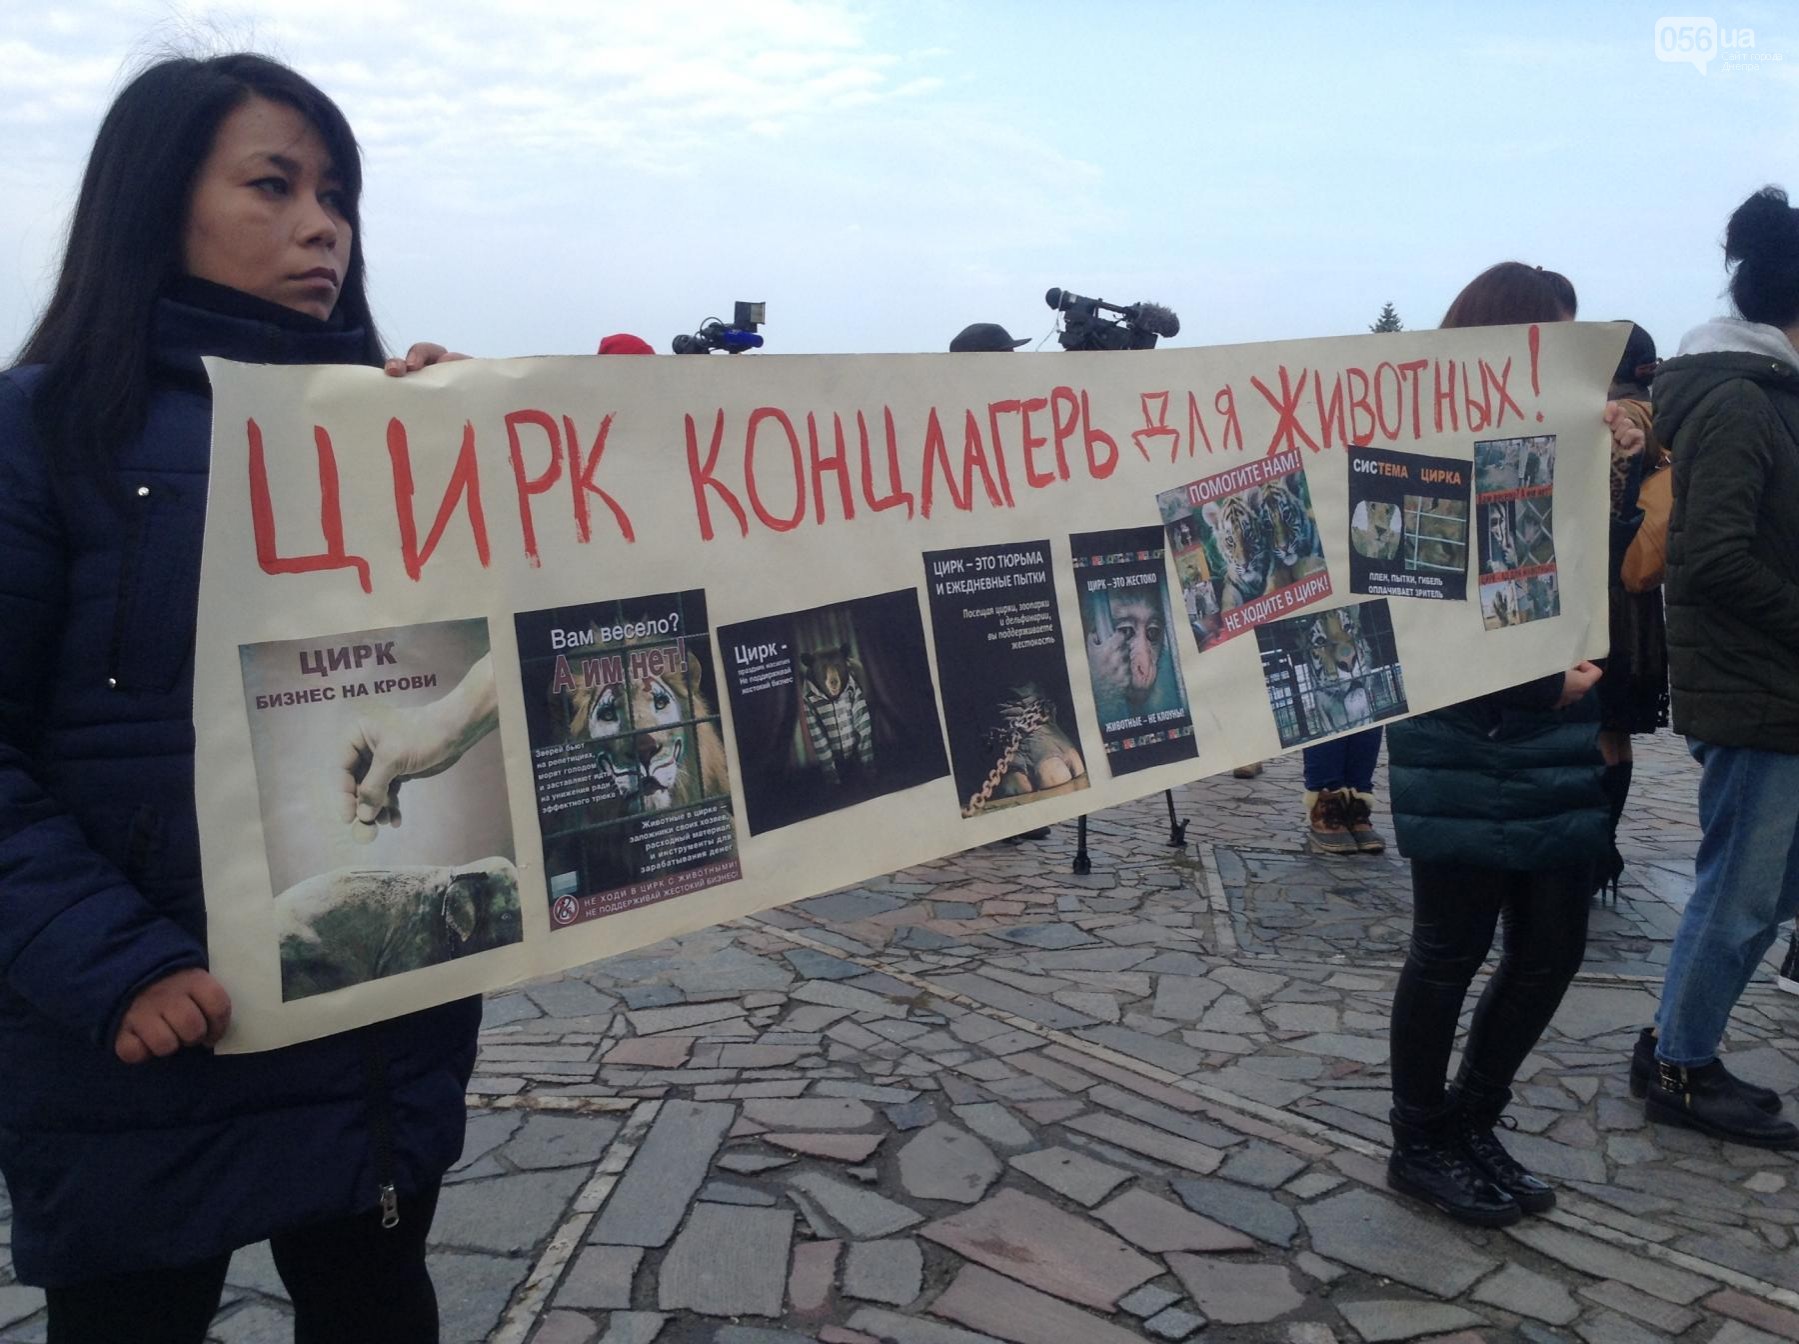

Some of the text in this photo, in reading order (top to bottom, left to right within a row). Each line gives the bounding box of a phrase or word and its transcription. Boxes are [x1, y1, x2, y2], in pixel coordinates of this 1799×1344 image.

[246, 325, 1545, 594] ЦИРК КОНЦЛАГЕРЬ ДЛЯ ЖИВОТНЫХ!
[1189, 450, 1300, 504] ПОМОГИТЕ НАМ!
[1353, 458, 1461, 485] СИСТЕМА ЦИРКА
[933, 559, 965, 578] ЦИРК
[975, 555, 996, 571] ЭТО
[997, 551, 1044, 568] ТЮРЬМА
[936, 571, 1046, 595] И ЕЖЕДНЕВНЫЕ ПЫТКИ
[1087, 578, 1107, 592] ЦИРК
[1112, 576, 1125, 589] ЭТО
[1126, 572, 1157, 587] ЖЕСТОКО
[1369, 572, 1443, 586] ПЛЕН, ПЫТКИ, ГИБЕЛЬ
[1368, 585, 1444, 599] ОПЛАЧИВАЕТ ЗРИТЕЛЬ
[963, 607, 994, 619] Посещая
[1018, 600, 1050, 612] зоопарки
[1224, 576, 1329, 632] НЕ ХОДИТЕ В ЦИРК!
[551, 612, 680, 649] Вам весело?
[987, 624, 1053, 641] вы поддерживаете
[734, 642, 778, 665] Цирк
[1011, 636, 1056, 650] жестокость
[300, 641, 398, 677] ЦИРК
[553, 636, 688, 694] А им нет!
[256, 673, 437, 710] БИЗНЕС НА КРОВИ
[1105, 716, 1143, 733] ЖИВОТНЫЕ
[1147, 713, 1157, 724] НЕ
[536, 743, 585, 758] Зверей бьют
[538, 763, 597, 780] морят голодом
[547, 775, 592, 790] заставляют
[543, 792, 616, 814] эффектного трюка
[552, 787, 590, 802] унижения
[592, 782, 611, 792] ради
[642, 814, 685, 829] Животные
[694, 806, 718, 817] цирке
[629, 827, 674, 843] заложники
[675, 821, 699, 832] своих
[645, 824, 731, 852] расходный материал
[658, 839, 714, 857] инструменты
[716, 834, 732, 844] для
[640, 844, 733, 873] зарабатывания денег
[584, 861, 738, 907] НЕ ХОДИ В ЦИРК С ЖИВОТНЫМИ!
[585, 871, 739, 918] НЕ ПОДДЕРЖИВАЙ ЖЕСТОКИЙ БИЗНЕС!
